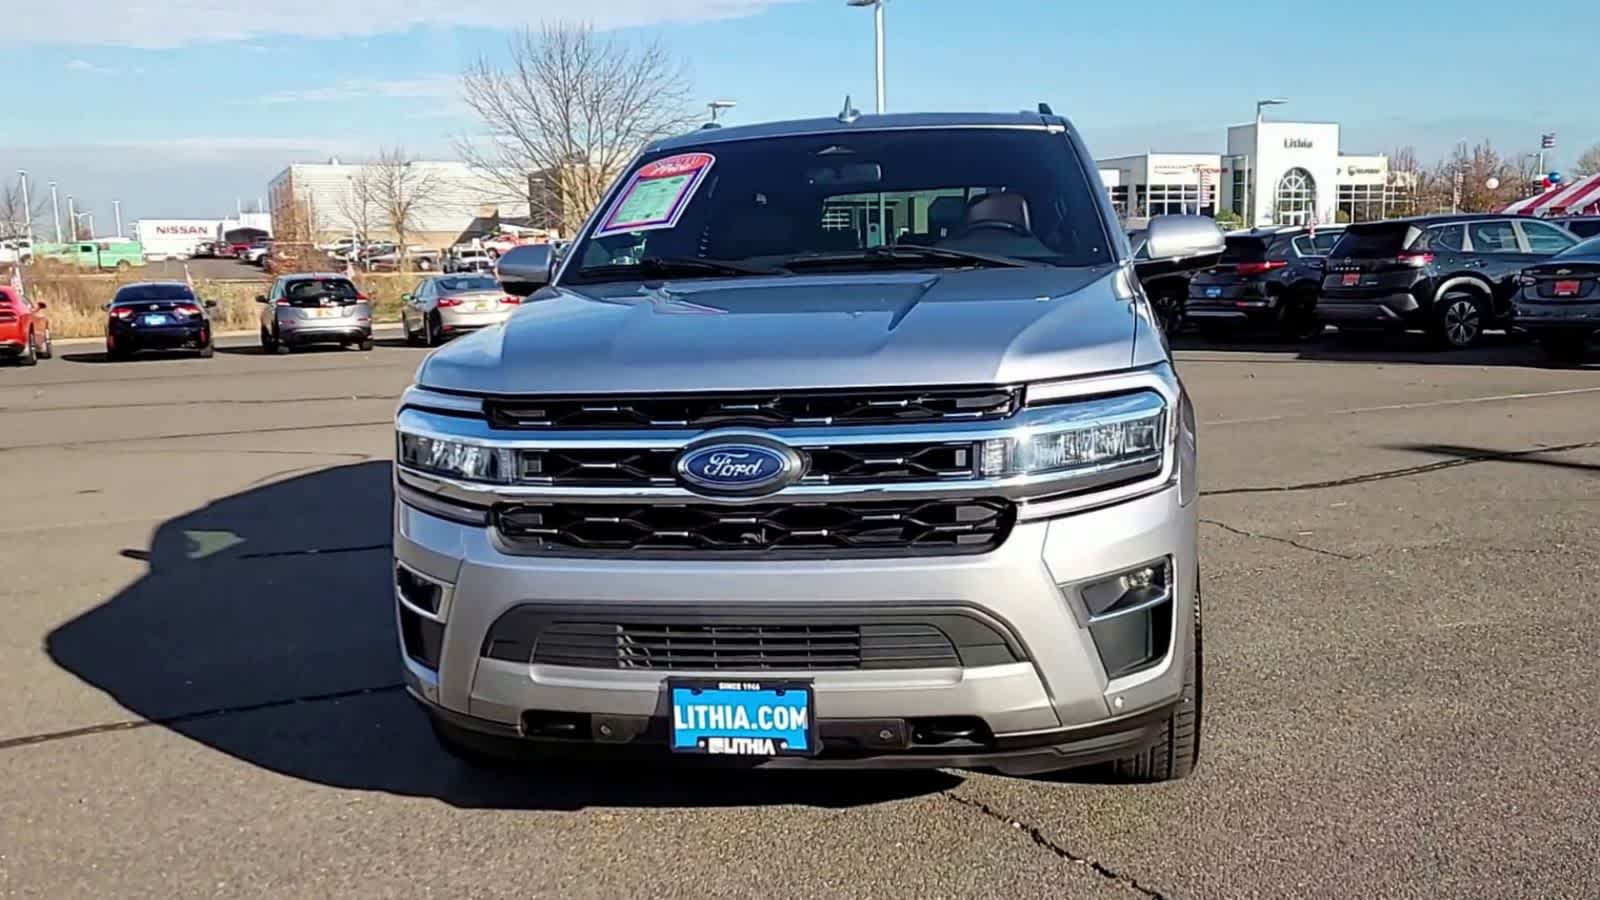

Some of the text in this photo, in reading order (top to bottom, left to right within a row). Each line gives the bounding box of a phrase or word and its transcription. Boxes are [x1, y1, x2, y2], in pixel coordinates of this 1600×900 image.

[1284, 138, 1313, 149] Lithia
[156, 226, 208, 235] NISSAN
[703, 453, 763, 477] Ford
[718, 682, 741, 690] SINCE
[673, 704, 808, 730] LITHIA.COM
[724, 738, 776, 755] LITHIA
